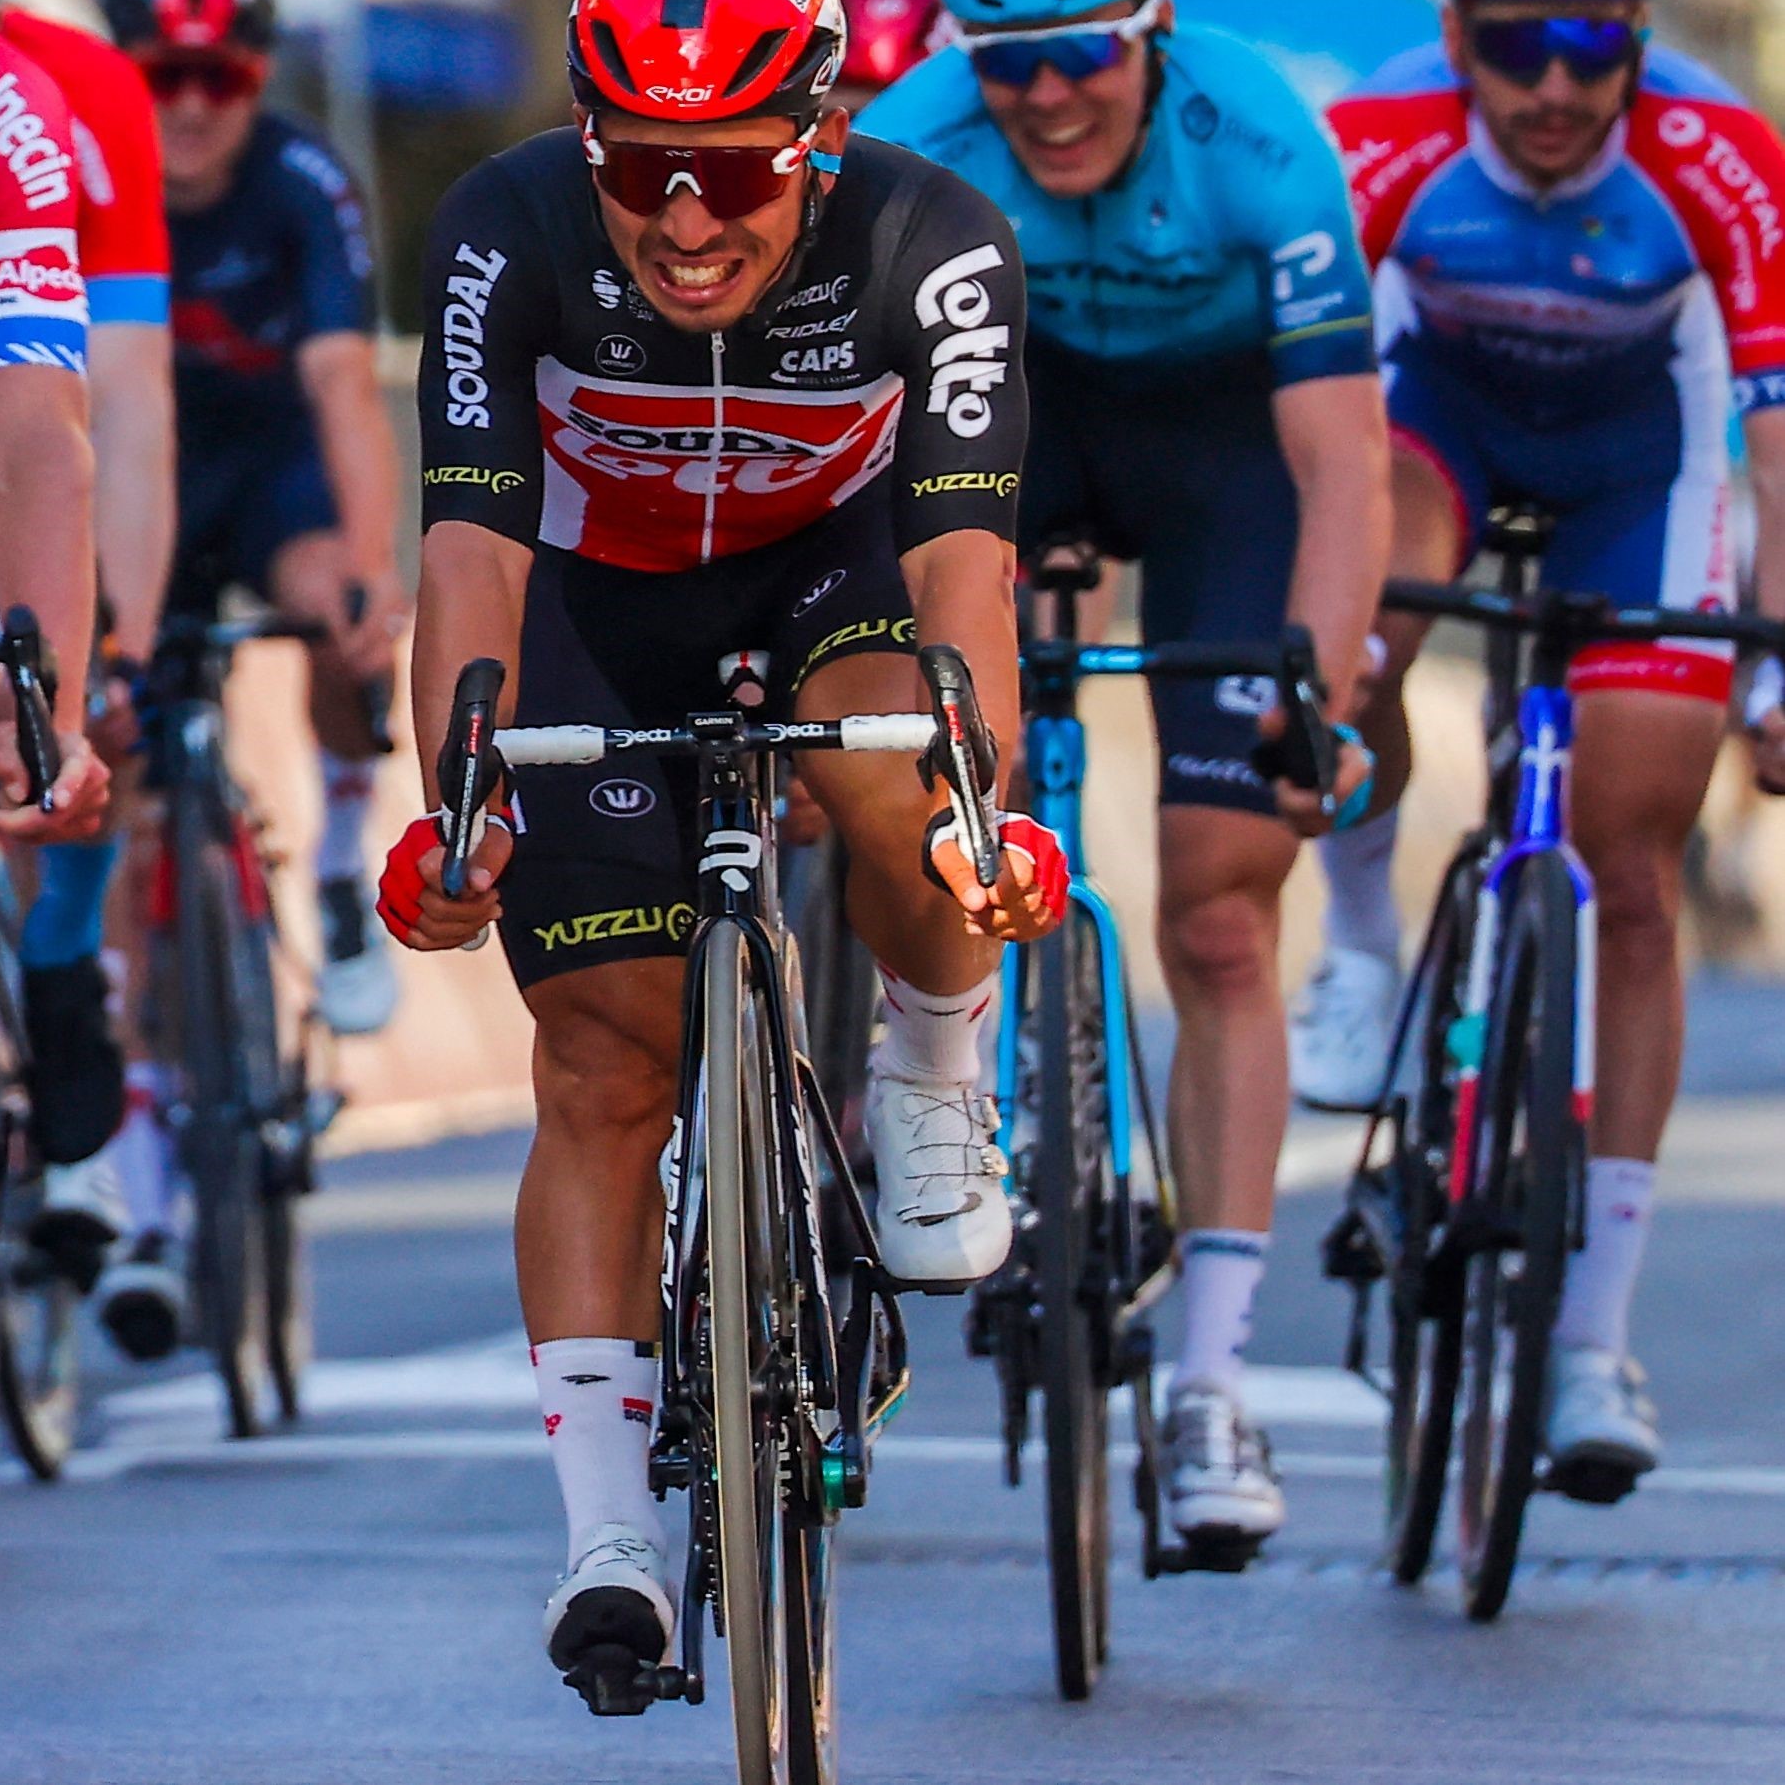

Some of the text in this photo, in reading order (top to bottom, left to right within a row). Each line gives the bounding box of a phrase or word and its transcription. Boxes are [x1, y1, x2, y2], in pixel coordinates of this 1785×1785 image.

[447, 243, 508, 430] SOUDAL
[779, 341, 856, 372] CAPS
[911, 471, 998, 499] YUZZU
[694, 716, 734, 726] GARMIN
[764, 722, 825, 743] Deda
[610, 728, 672, 749] Deda
[533, 908, 663, 952] YUZZU
